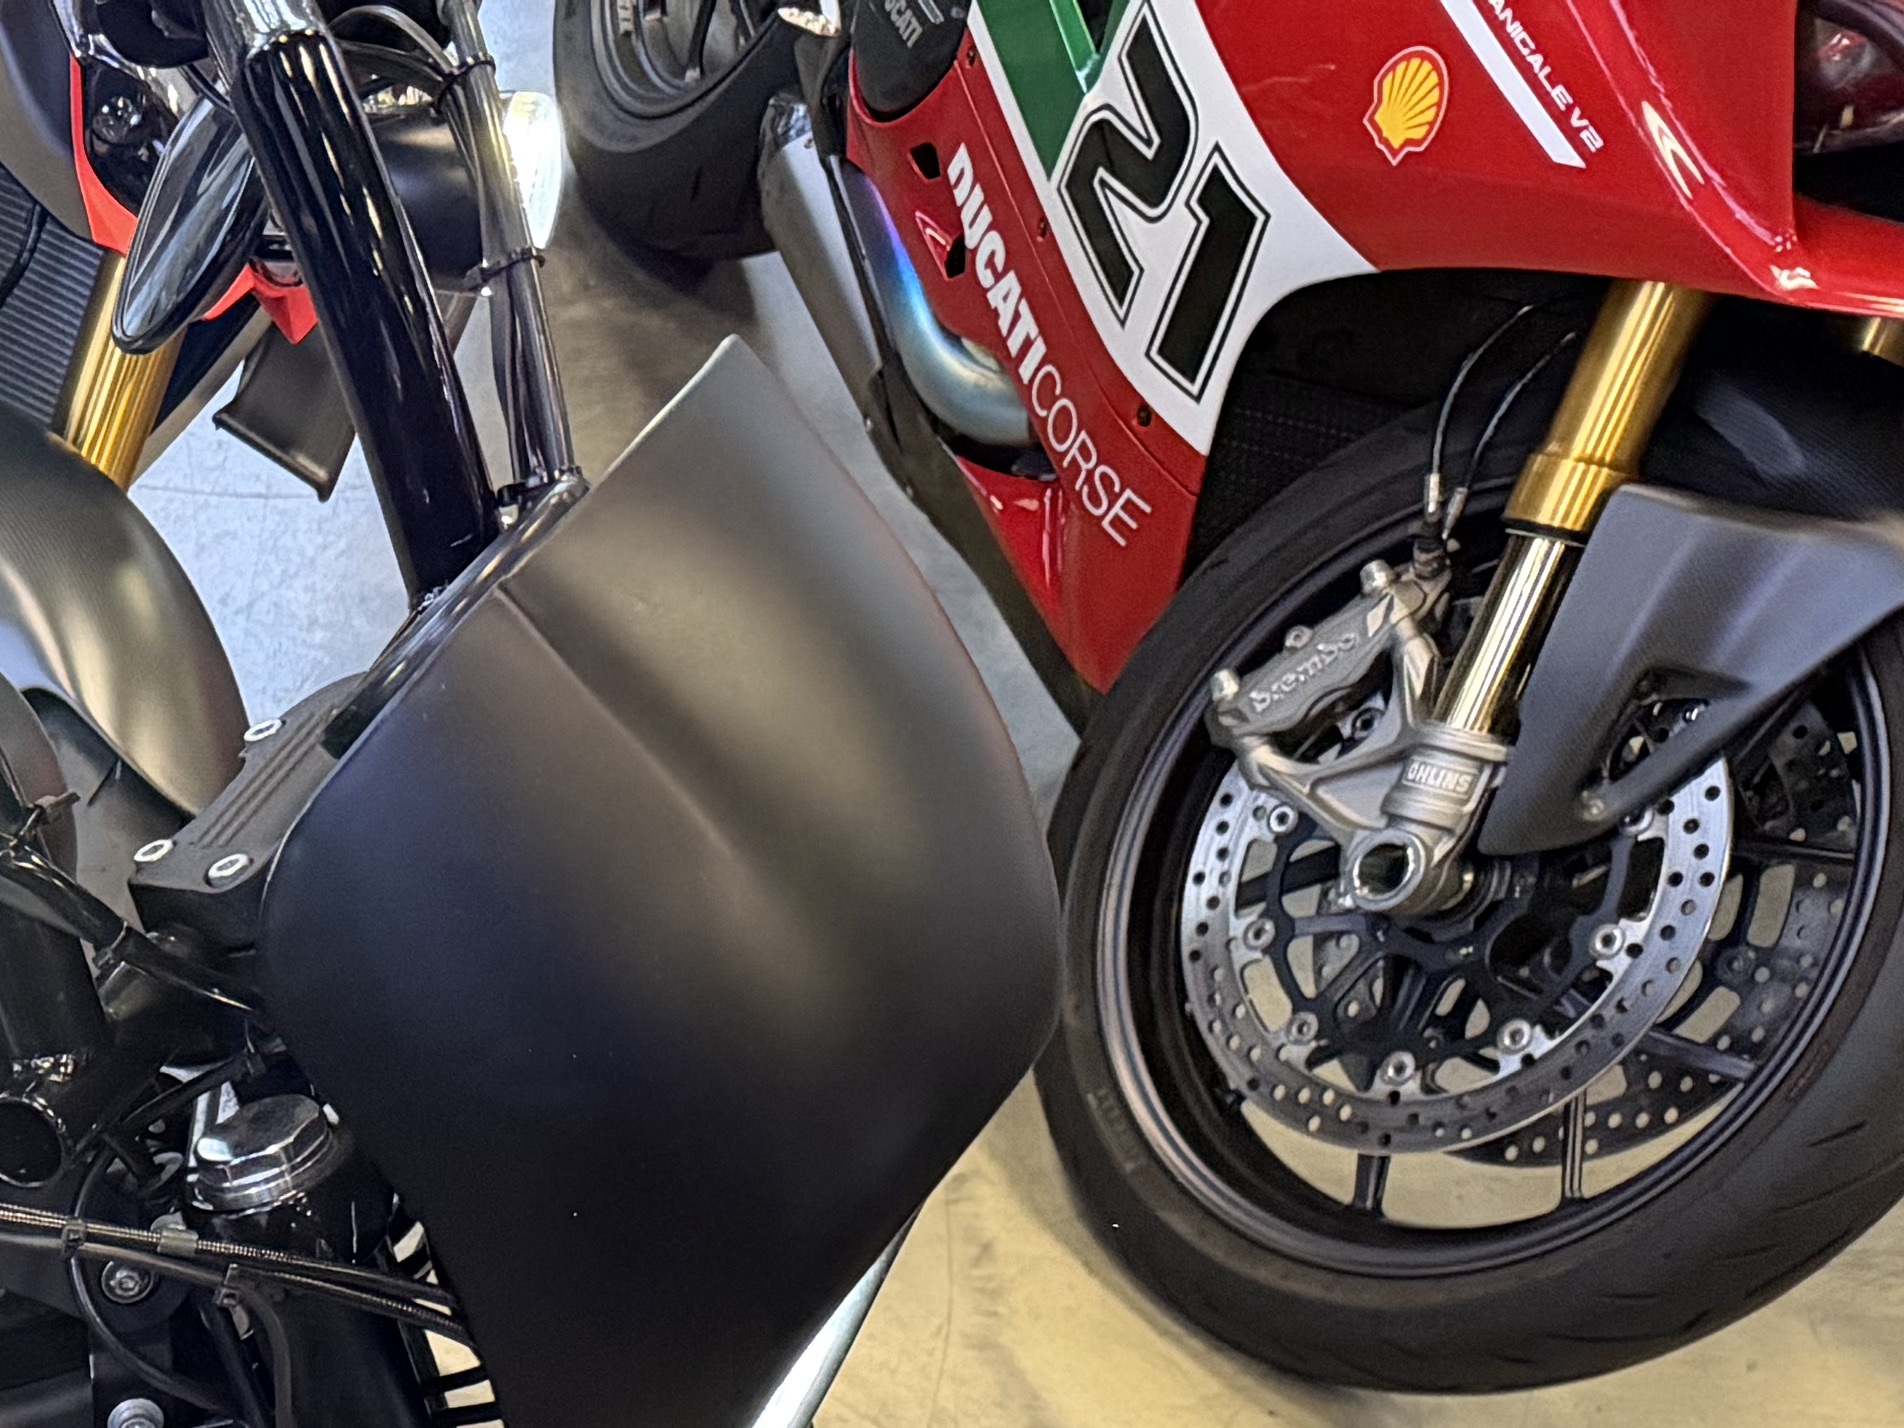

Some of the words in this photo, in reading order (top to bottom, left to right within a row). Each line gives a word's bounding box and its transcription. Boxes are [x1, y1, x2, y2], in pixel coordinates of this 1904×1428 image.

[883, 0, 923, 48] UCATI
[1489, 0, 1573, 111] ANIGALE
[1570, 107, 1604, 152] V2
[1057, 0, 1271, 405] 21
[1249, 632, 1359, 713] brembo
